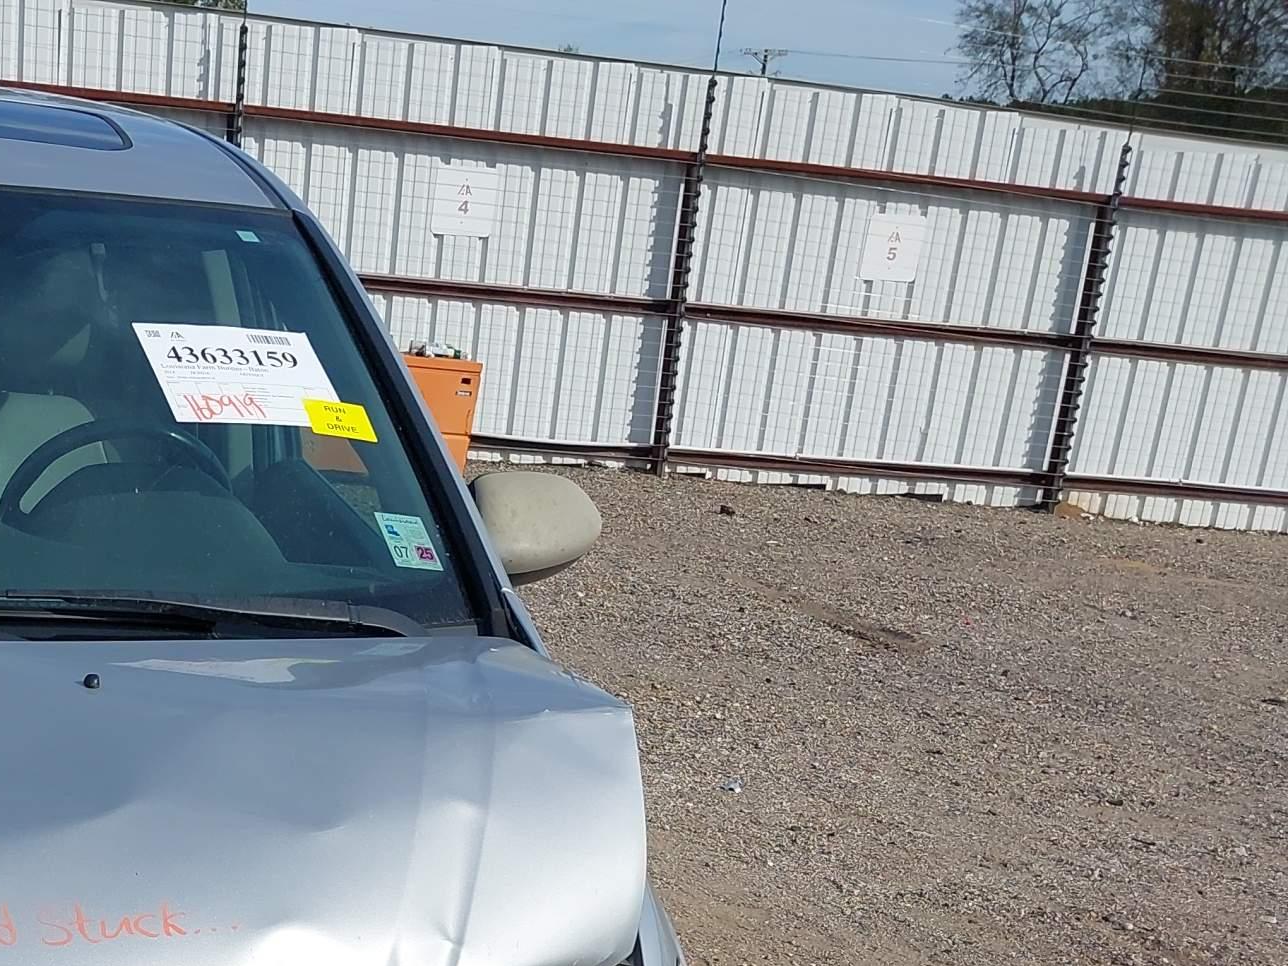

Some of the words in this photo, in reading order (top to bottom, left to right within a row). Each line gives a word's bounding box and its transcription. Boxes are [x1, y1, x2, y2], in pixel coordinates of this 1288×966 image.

[457, 200, 469, 214] 4
[886, 247, 897, 261] 5
[166, 345, 299, 369] 43633159
[323, 405, 347, 415] RUN
[326, 422, 359, 434] DRIVE
[393, 545, 409, 559] 07
[416, 547, 434, 560] 25
